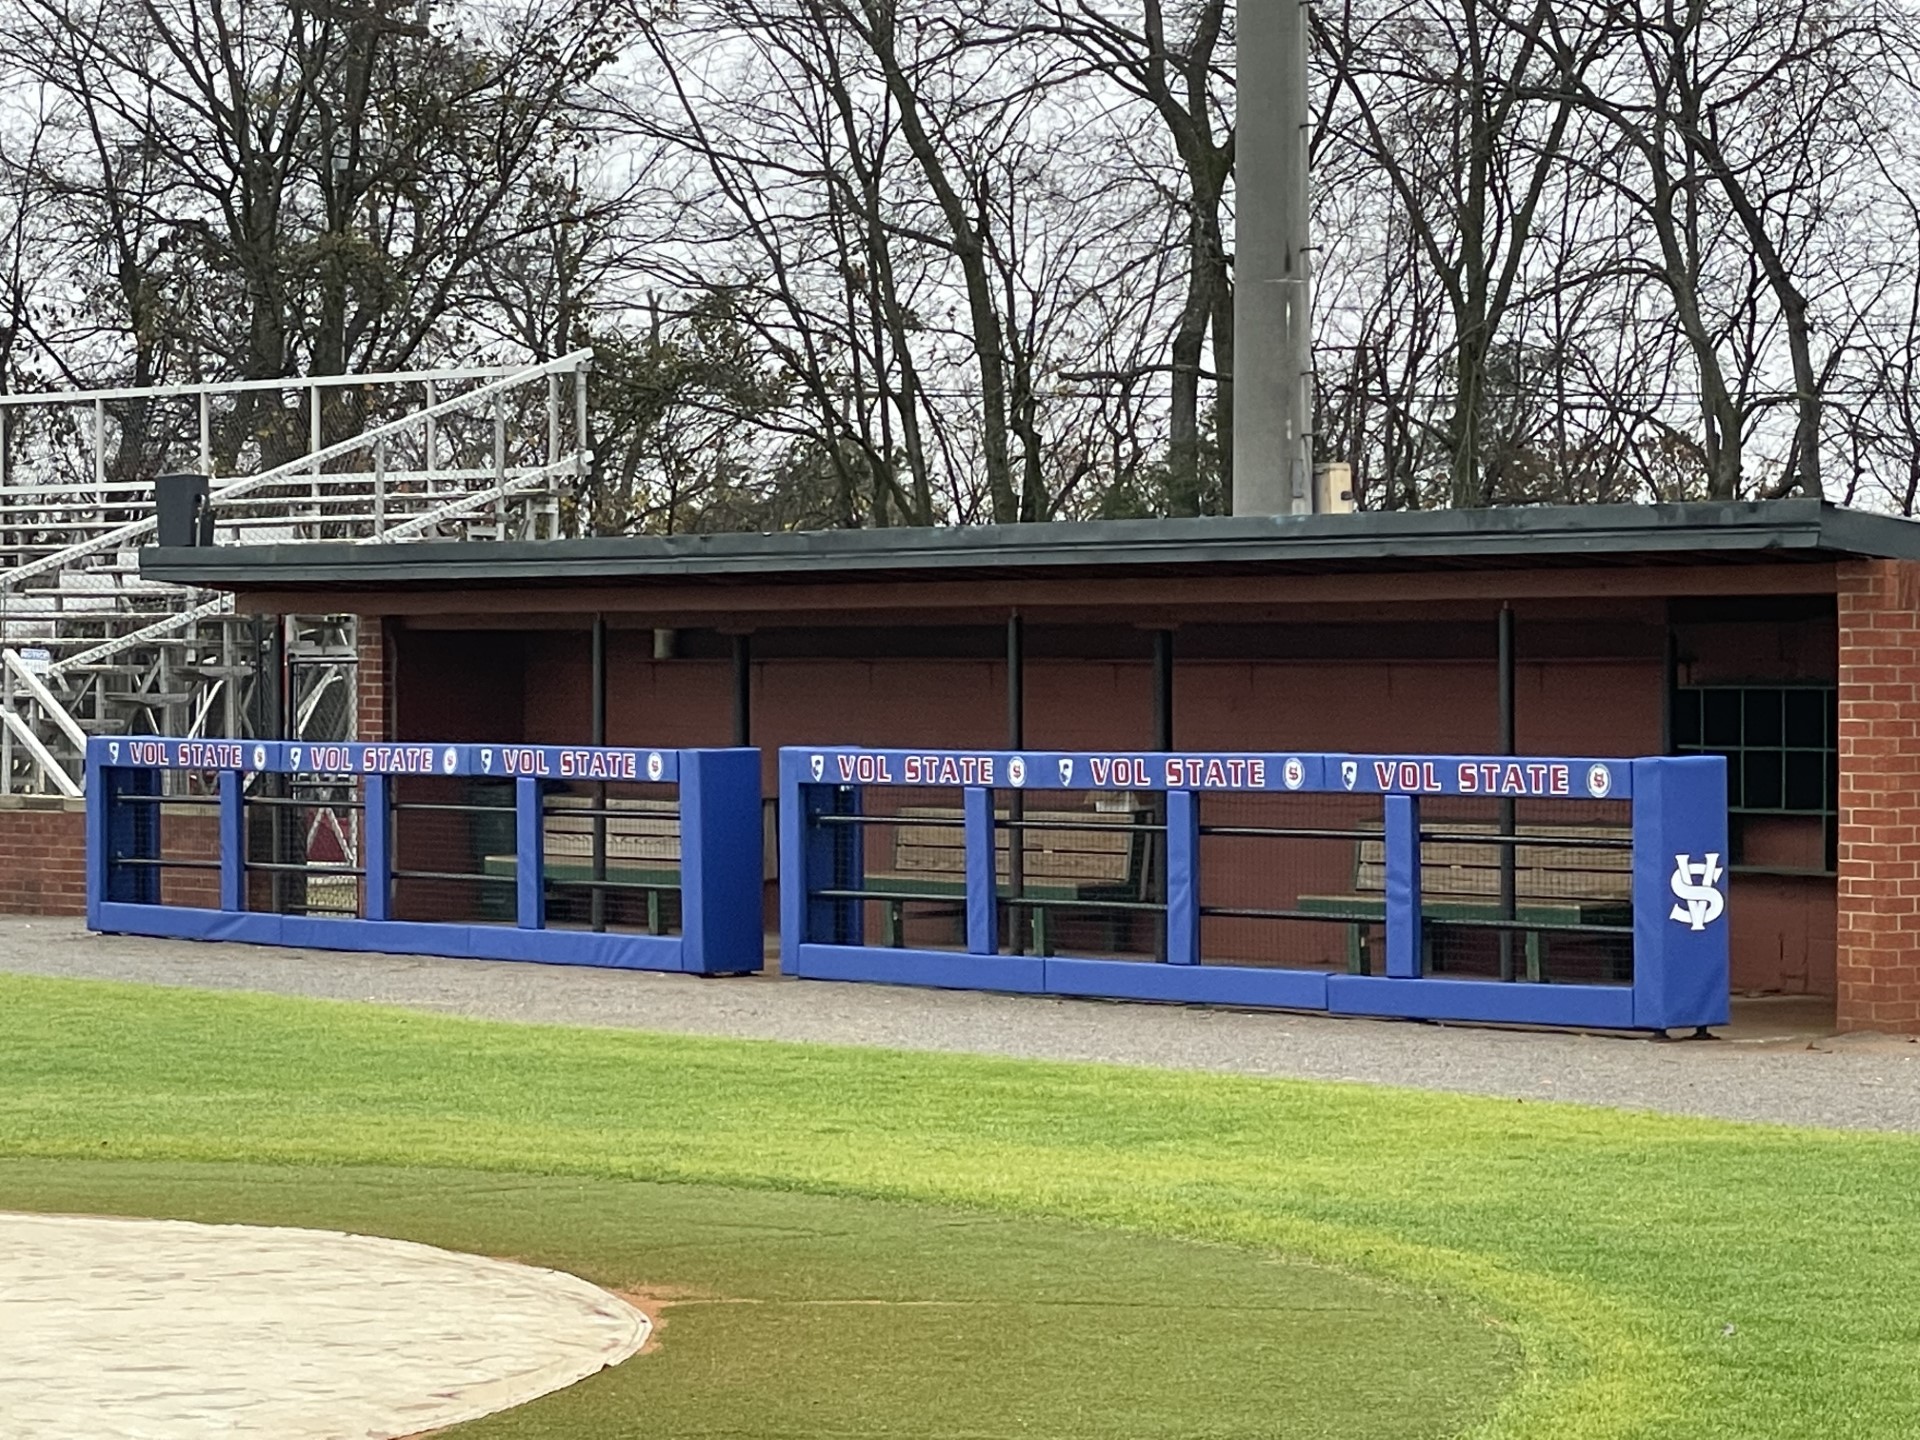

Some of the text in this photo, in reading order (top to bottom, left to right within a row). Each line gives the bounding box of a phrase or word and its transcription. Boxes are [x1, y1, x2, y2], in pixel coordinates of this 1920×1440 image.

[129, 742, 169, 765] VOL
[178, 743, 243, 767] STATE
[310, 747, 353, 770] VOL
[363, 748, 433, 772] STATE
[502, 749, 549, 775] VOL
[560, 751, 636, 778] STATE
[837, 755, 892, 782] VOL
[905, 756, 993, 784] STATE
[1090, 758, 1150, 786] VOL
[1165, 758, 1265, 787] STATE
[1373, 761, 1442, 791] VOL
[1458, 763, 1569, 794] STATE
